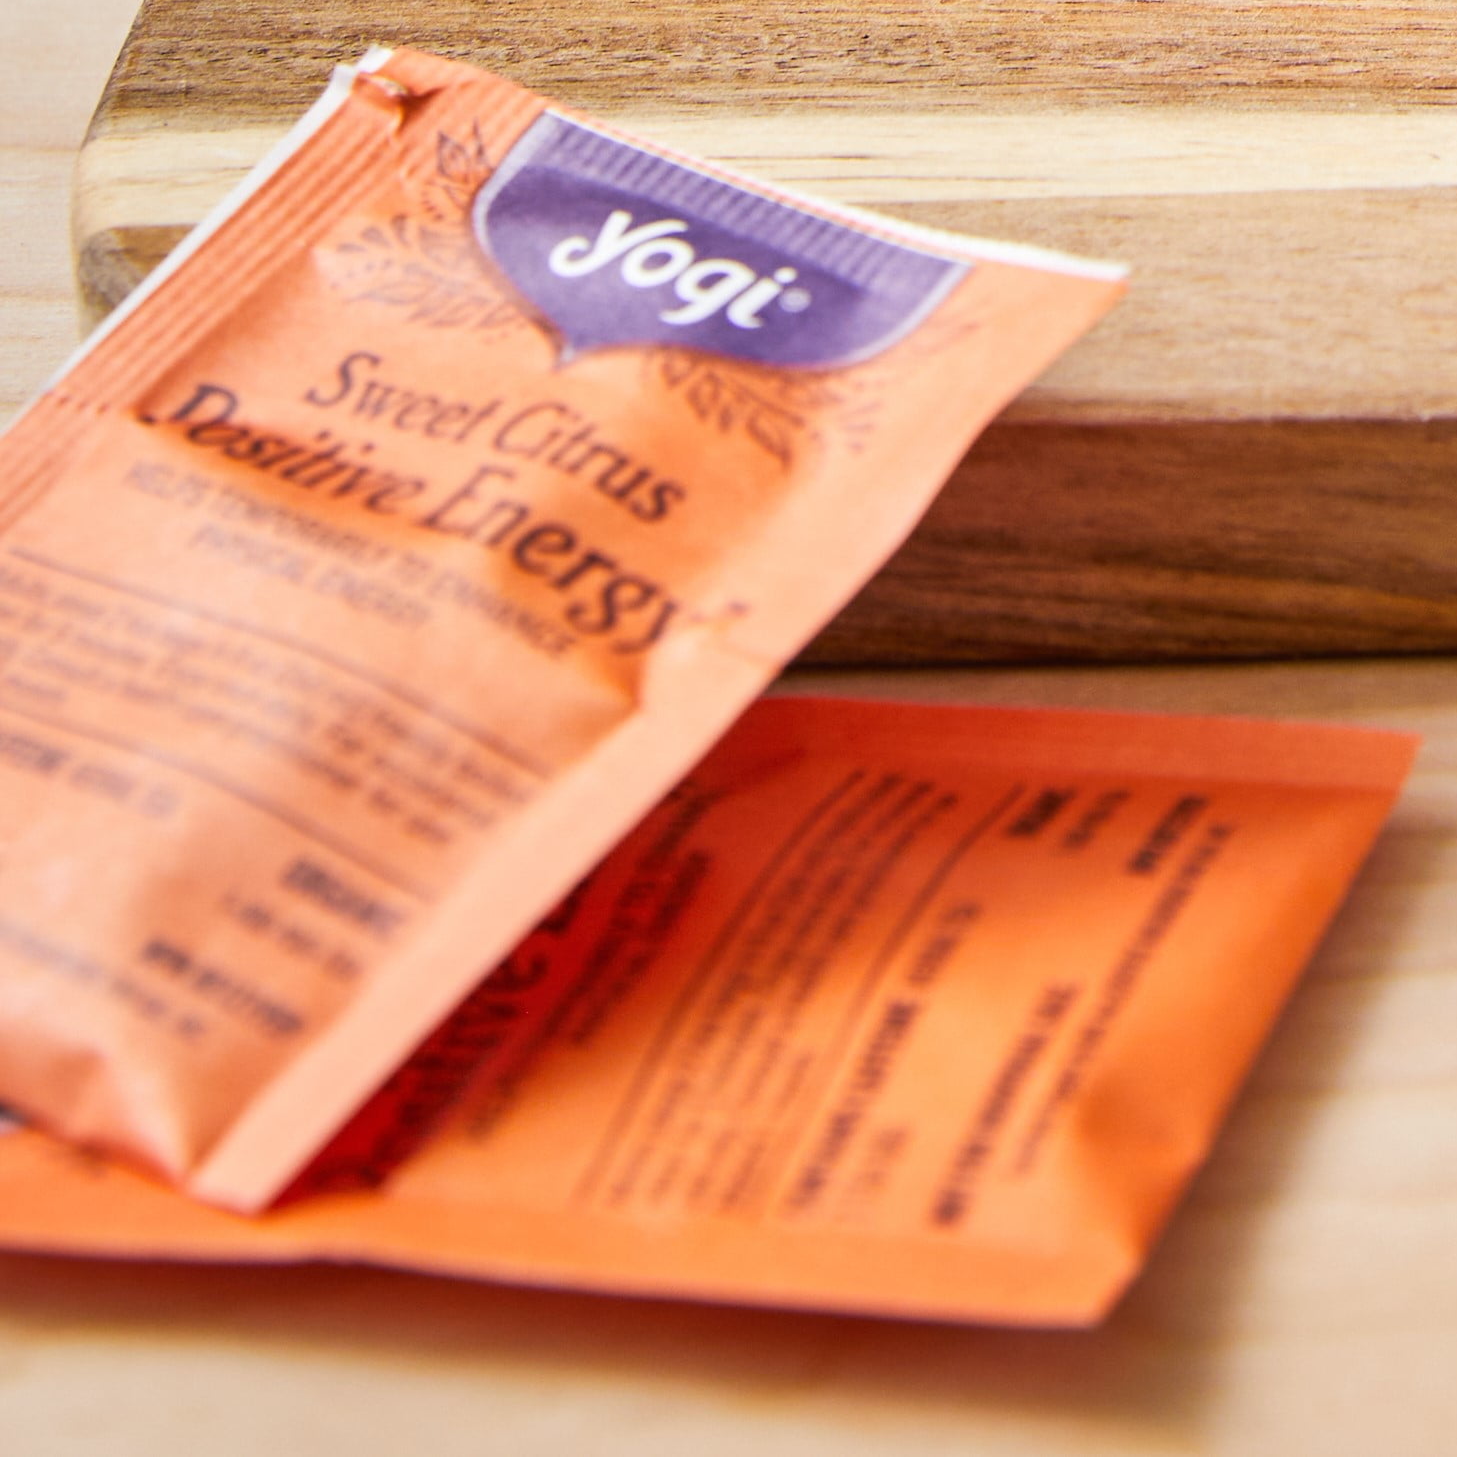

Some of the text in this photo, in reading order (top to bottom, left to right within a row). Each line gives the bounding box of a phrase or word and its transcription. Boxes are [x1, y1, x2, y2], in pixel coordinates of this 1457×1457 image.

[141, 384, 428, 517] Positive
[305, 351, 687, 524] Sweet Citrus
